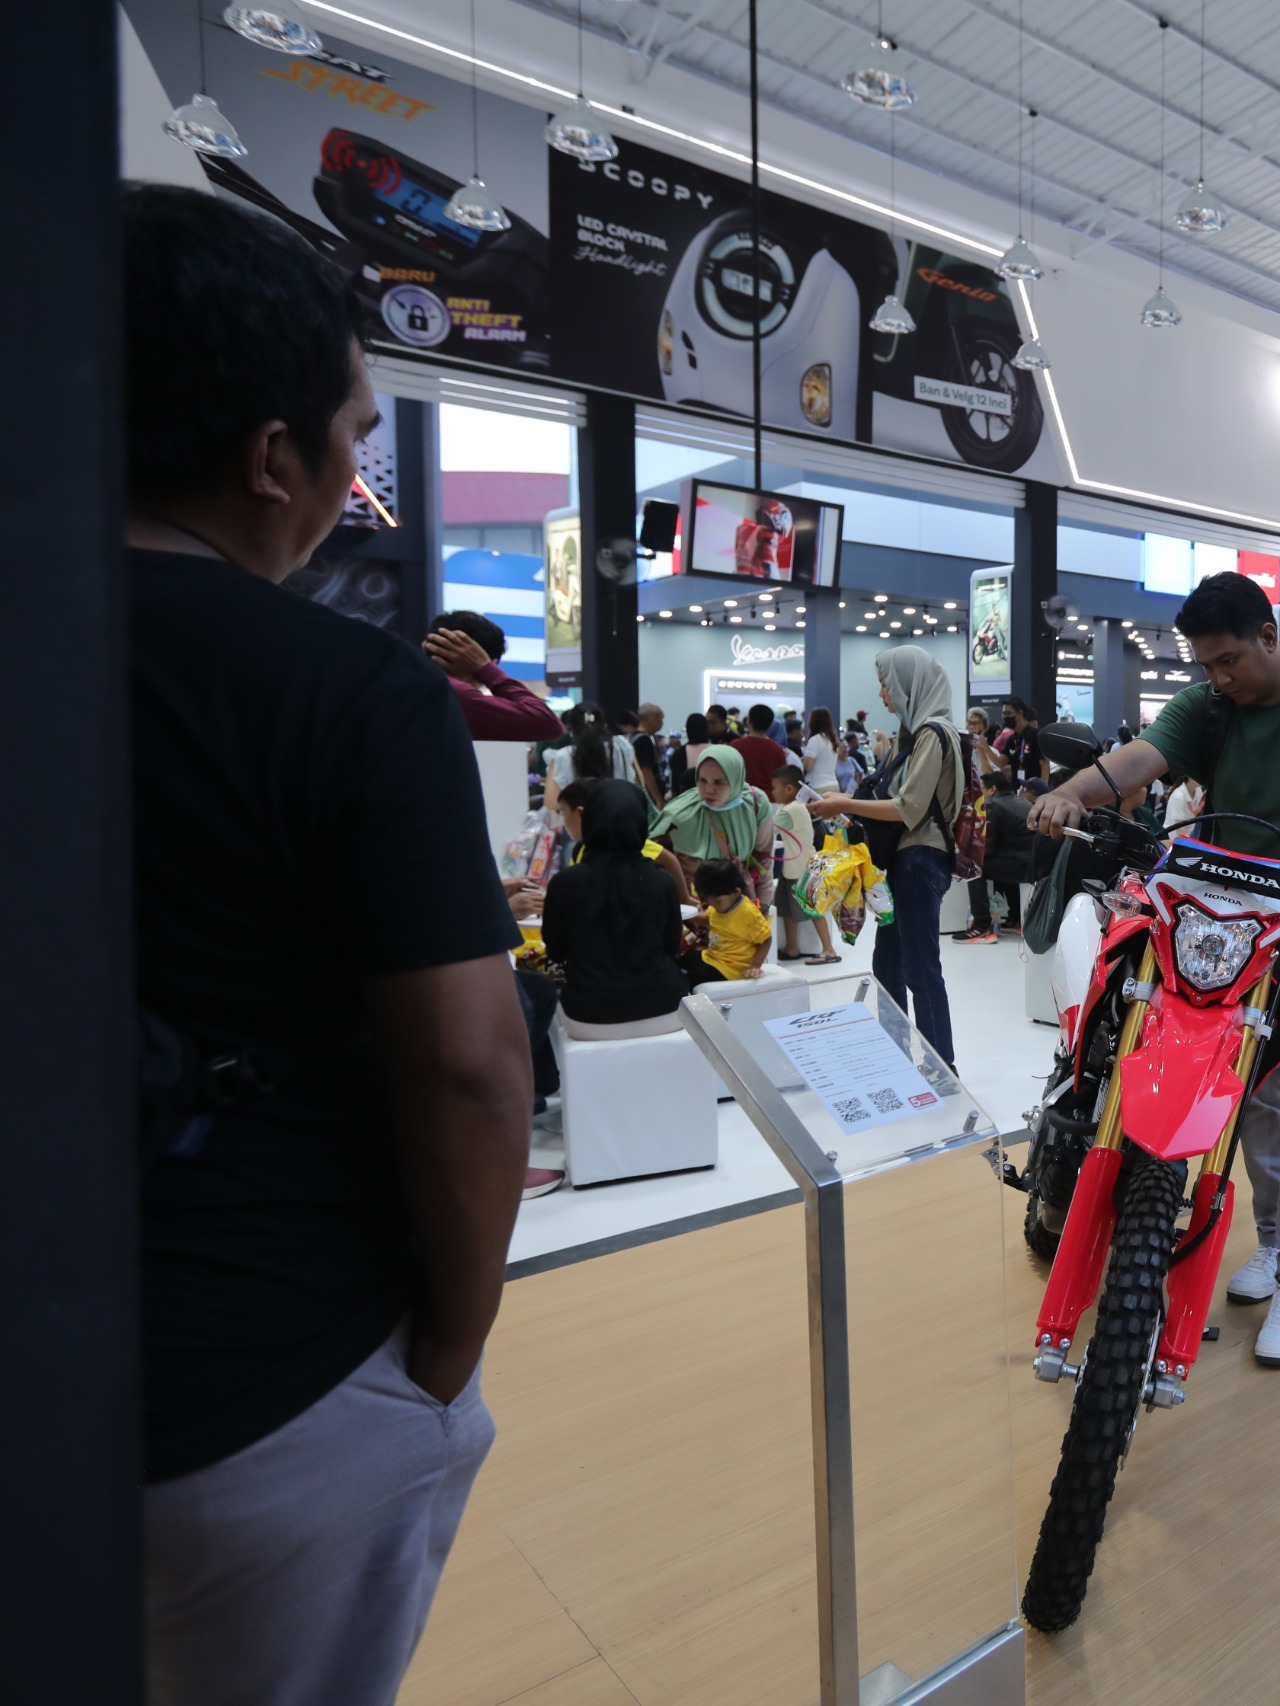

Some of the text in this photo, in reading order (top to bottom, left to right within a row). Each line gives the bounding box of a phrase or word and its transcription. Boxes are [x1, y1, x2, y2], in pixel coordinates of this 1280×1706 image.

[260, 60, 437, 121] STREET
[578, 154, 713, 209] SCOOPY
[577, 214, 668, 251] LED CRYSTAL
[577, 229, 625, 251] BLOCK
[573, 246, 668, 276] Headlight
[380, 267, 436, 282] BARU
[917, 267, 998, 302] Genio
[447, 298, 491, 311] ANTI
[452, 312, 522, 328] THEFT
[464, 328, 527, 342] ALARM
[919, 382, 1007, 409] Ban & Velg 12 Inci
[1200, 862, 1280, 890] HONDA
[1203, 892, 1243, 907] HONDA
[788, 1009, 847, 1026] CRF
